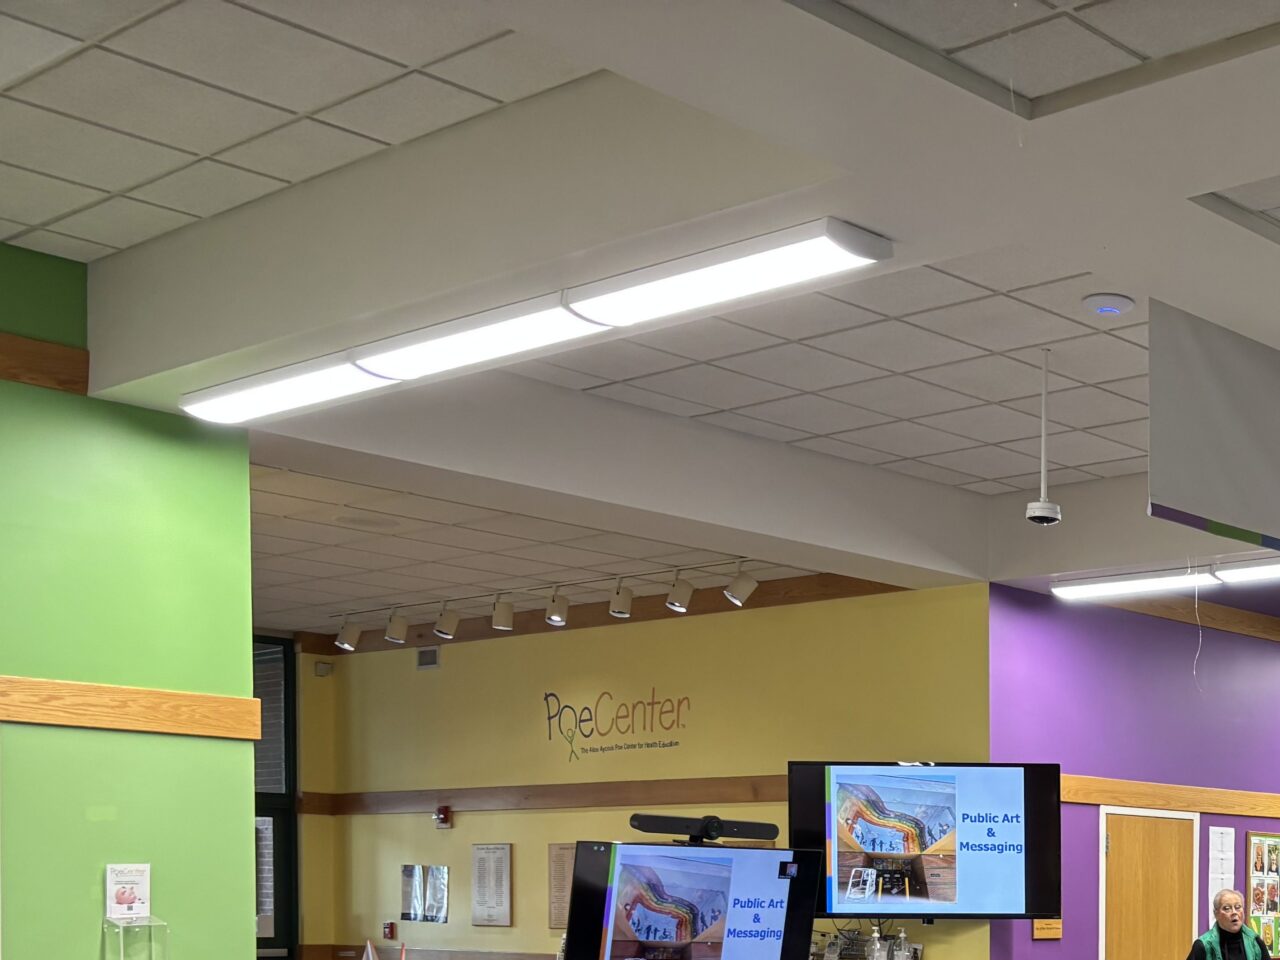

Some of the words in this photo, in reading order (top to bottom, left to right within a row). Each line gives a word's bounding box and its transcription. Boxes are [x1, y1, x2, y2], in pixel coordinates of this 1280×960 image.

[961, 812, 999, 823] Public
[1001, 813, 1021, 823] Art
[986, 827, 996, 837] &
[960, 841, 1023, 854] Messaging
[732, 897, 766, 909] Public
[767, 898, 785, 909] Art
[752, 913, 761, 923] &
[726, 927, 783, 941] Messaging
